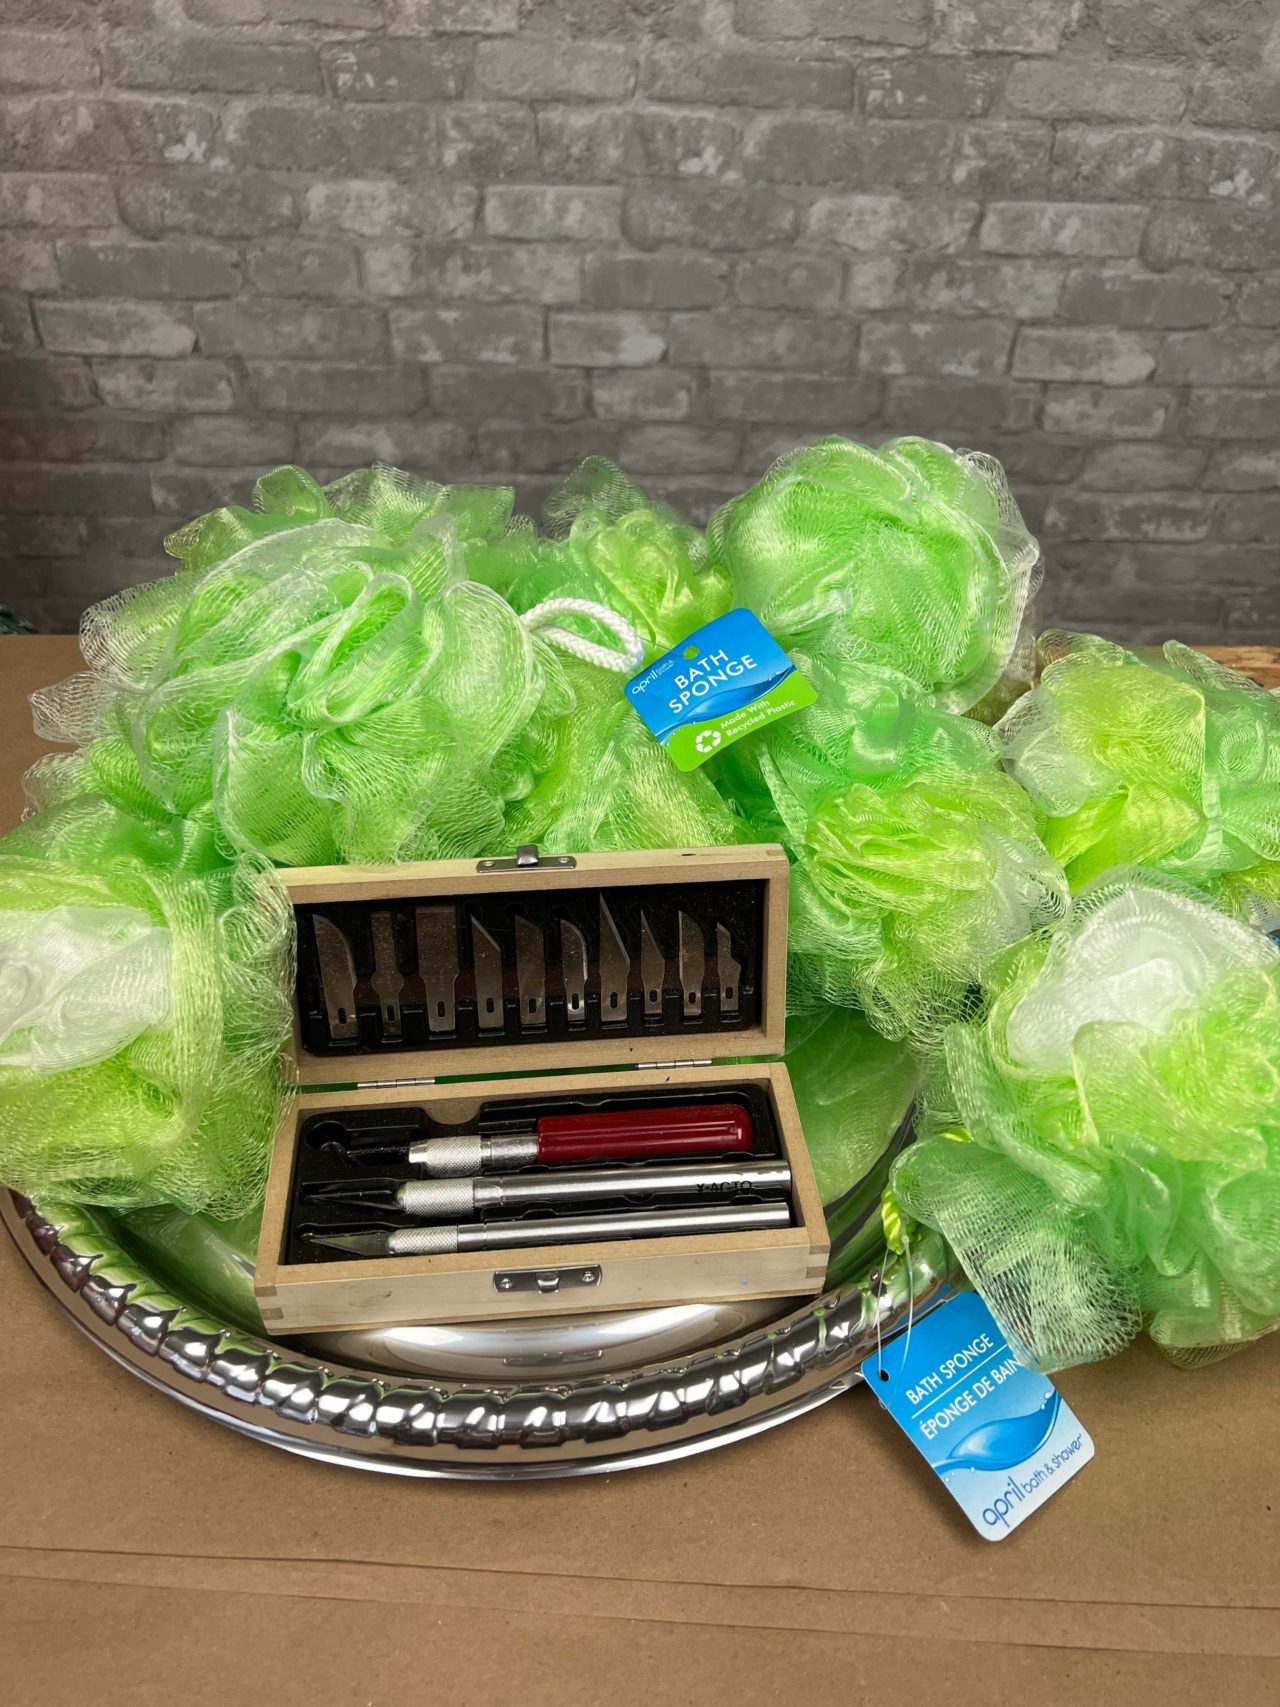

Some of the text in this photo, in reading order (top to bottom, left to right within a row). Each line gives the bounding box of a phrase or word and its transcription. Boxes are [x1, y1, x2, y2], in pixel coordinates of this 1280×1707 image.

[631, 669, 658, 695] april
[668, 654, 757, 714] SPONGE
[674, 649, 730, 690] BATH
[720, 700, 770, 729] Made With
[726, 700, 797, 737] Recycled Plastic
[905, 1333, 994, 1405] BATH SPONGE
[920, 1354, 1025, 1440] ÉPONGE DE BAIN
[982, 1437, 1083, 1528] april bath & shower
